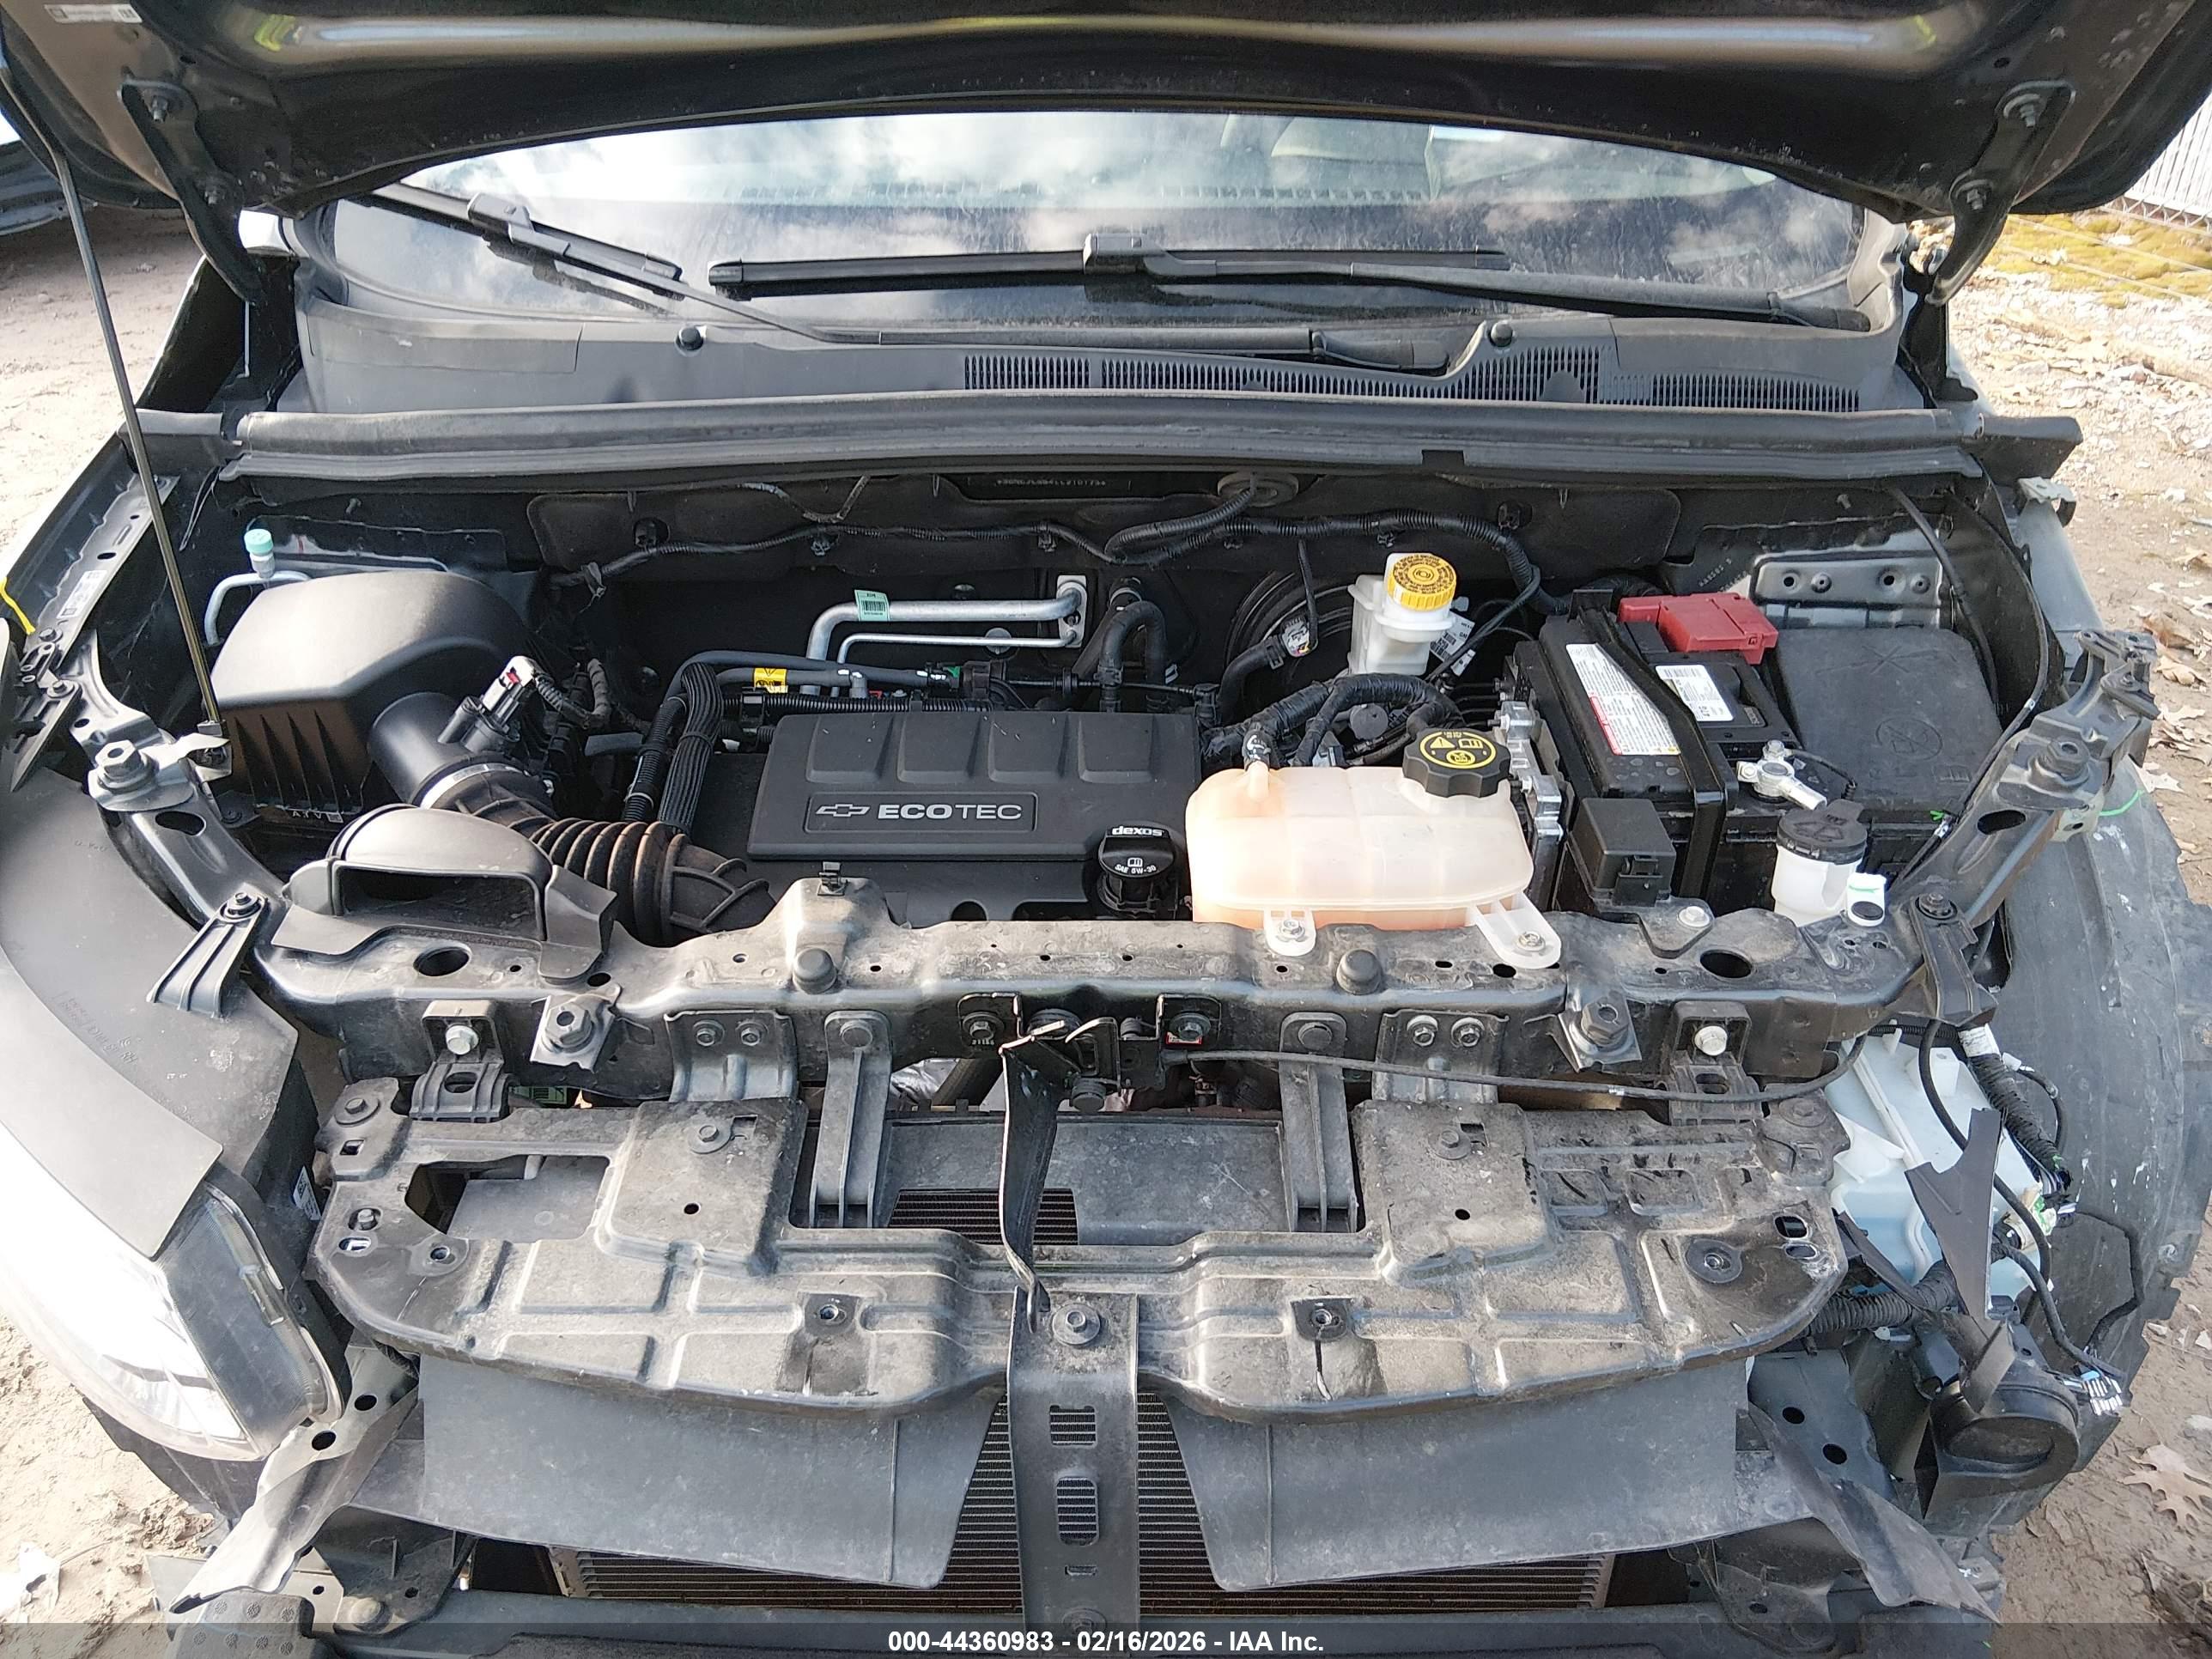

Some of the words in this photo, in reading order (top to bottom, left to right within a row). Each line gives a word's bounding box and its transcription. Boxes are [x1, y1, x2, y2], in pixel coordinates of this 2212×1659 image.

[878, 804, 1022, 820] ECOTEC
[1112, 825, 1163, 836] dexos
[1115, 864, 1129, 873] SAE
